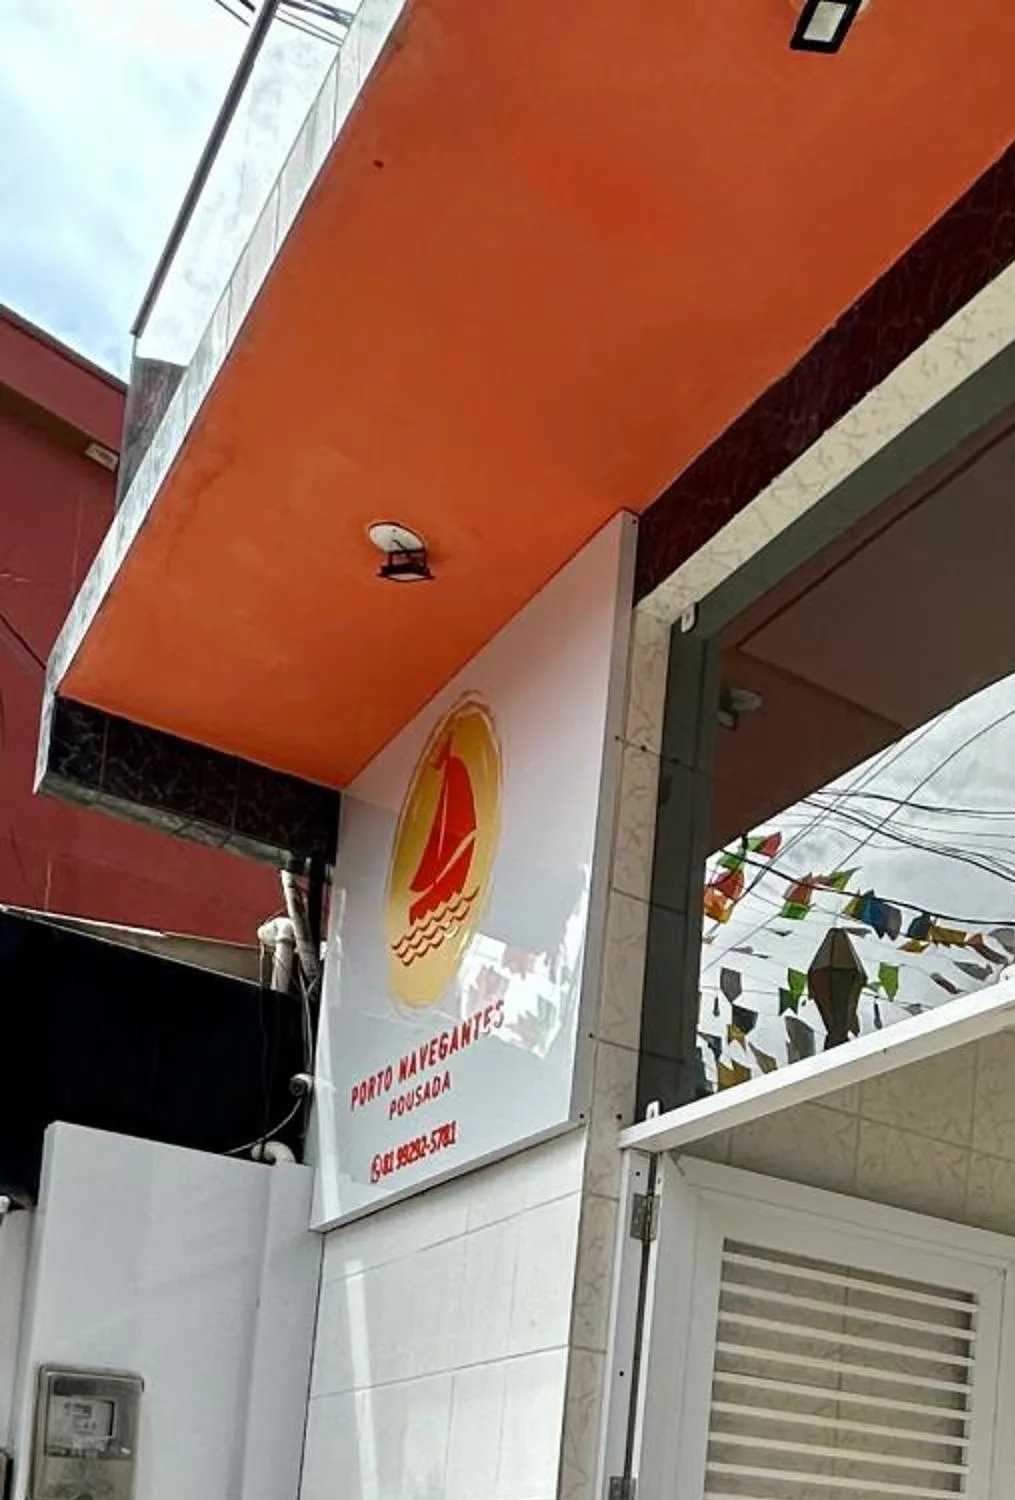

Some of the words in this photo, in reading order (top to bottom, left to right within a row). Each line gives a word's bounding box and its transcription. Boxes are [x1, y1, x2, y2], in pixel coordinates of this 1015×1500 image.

[351, 1064, 392, 1111] PORTO
[398, 1000, 505, 1082] NAVEGANTES
[389, 1071, 451, 1120] POUSADA
